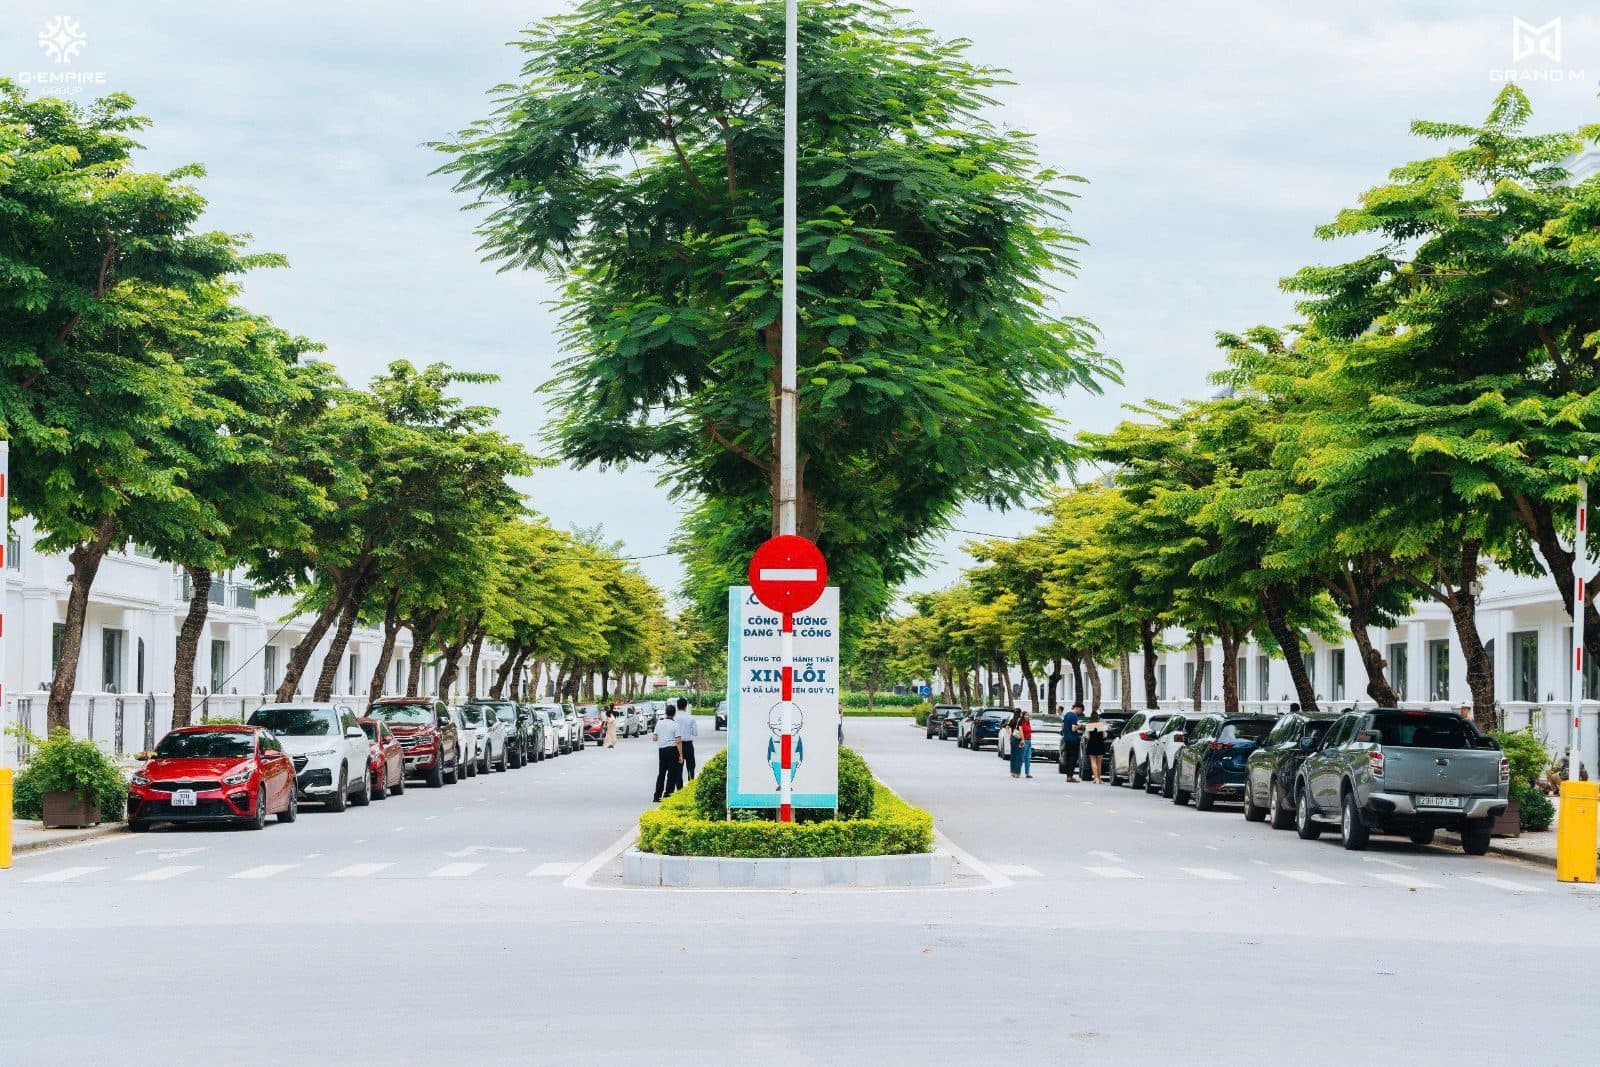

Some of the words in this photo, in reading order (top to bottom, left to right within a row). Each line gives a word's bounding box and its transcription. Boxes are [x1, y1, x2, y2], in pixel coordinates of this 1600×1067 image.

[748, 615, 778, 625] CÔNG
[791, 615, 828, 626] RƯỜNG
[744, 628, 773, 637] ĐANG
[777, 629, 797, 637] TI
[800, 627, 832, 637] CÔNG
[750, 669, 783, 682] XIN
[793, 662, 826, 683] LỖI
